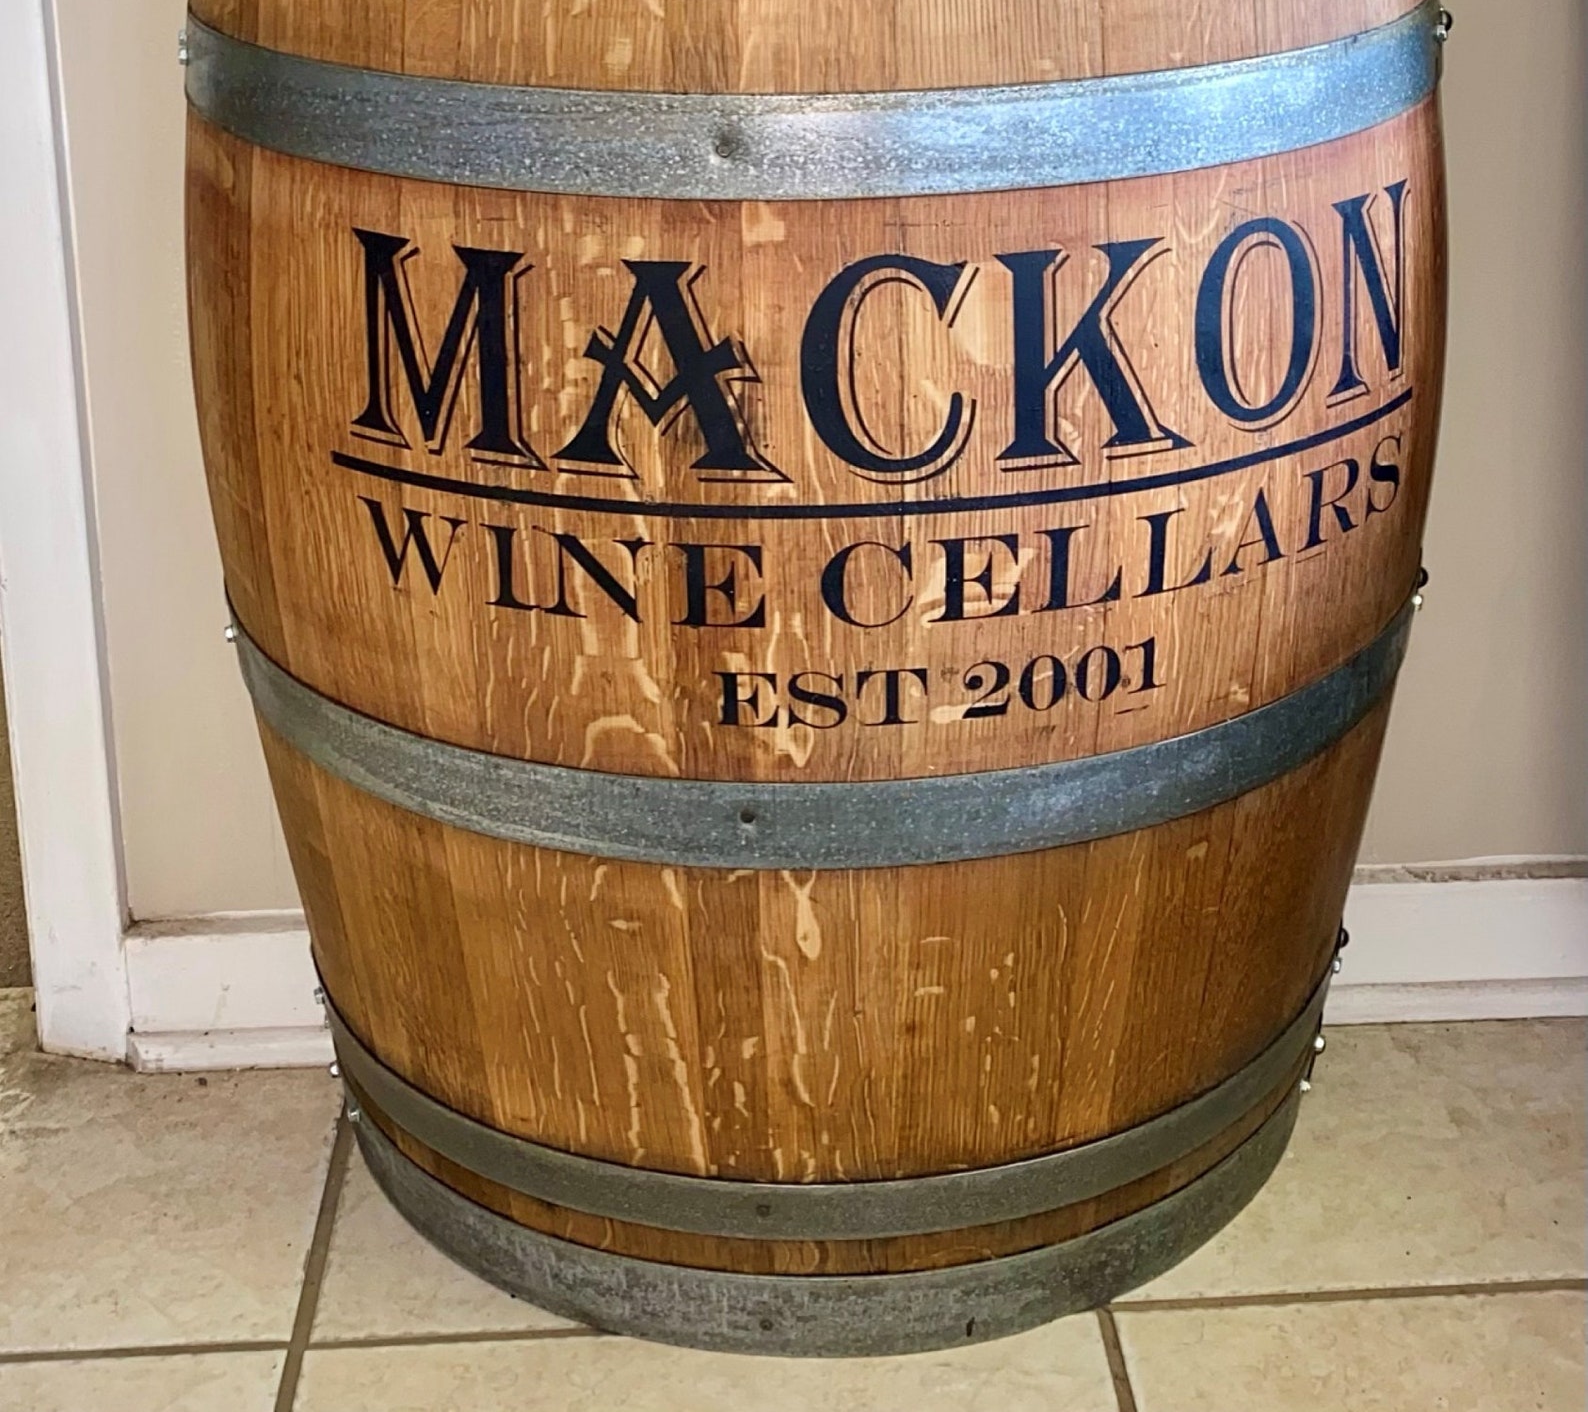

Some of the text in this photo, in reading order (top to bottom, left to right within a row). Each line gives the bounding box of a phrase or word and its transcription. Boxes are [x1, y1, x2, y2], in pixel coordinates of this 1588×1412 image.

[349, 178, 1411, 485] MACKON
[358, 435, 1402, 629] WINE CELLARS
[714, 638, 1166, 730] EST 2001
